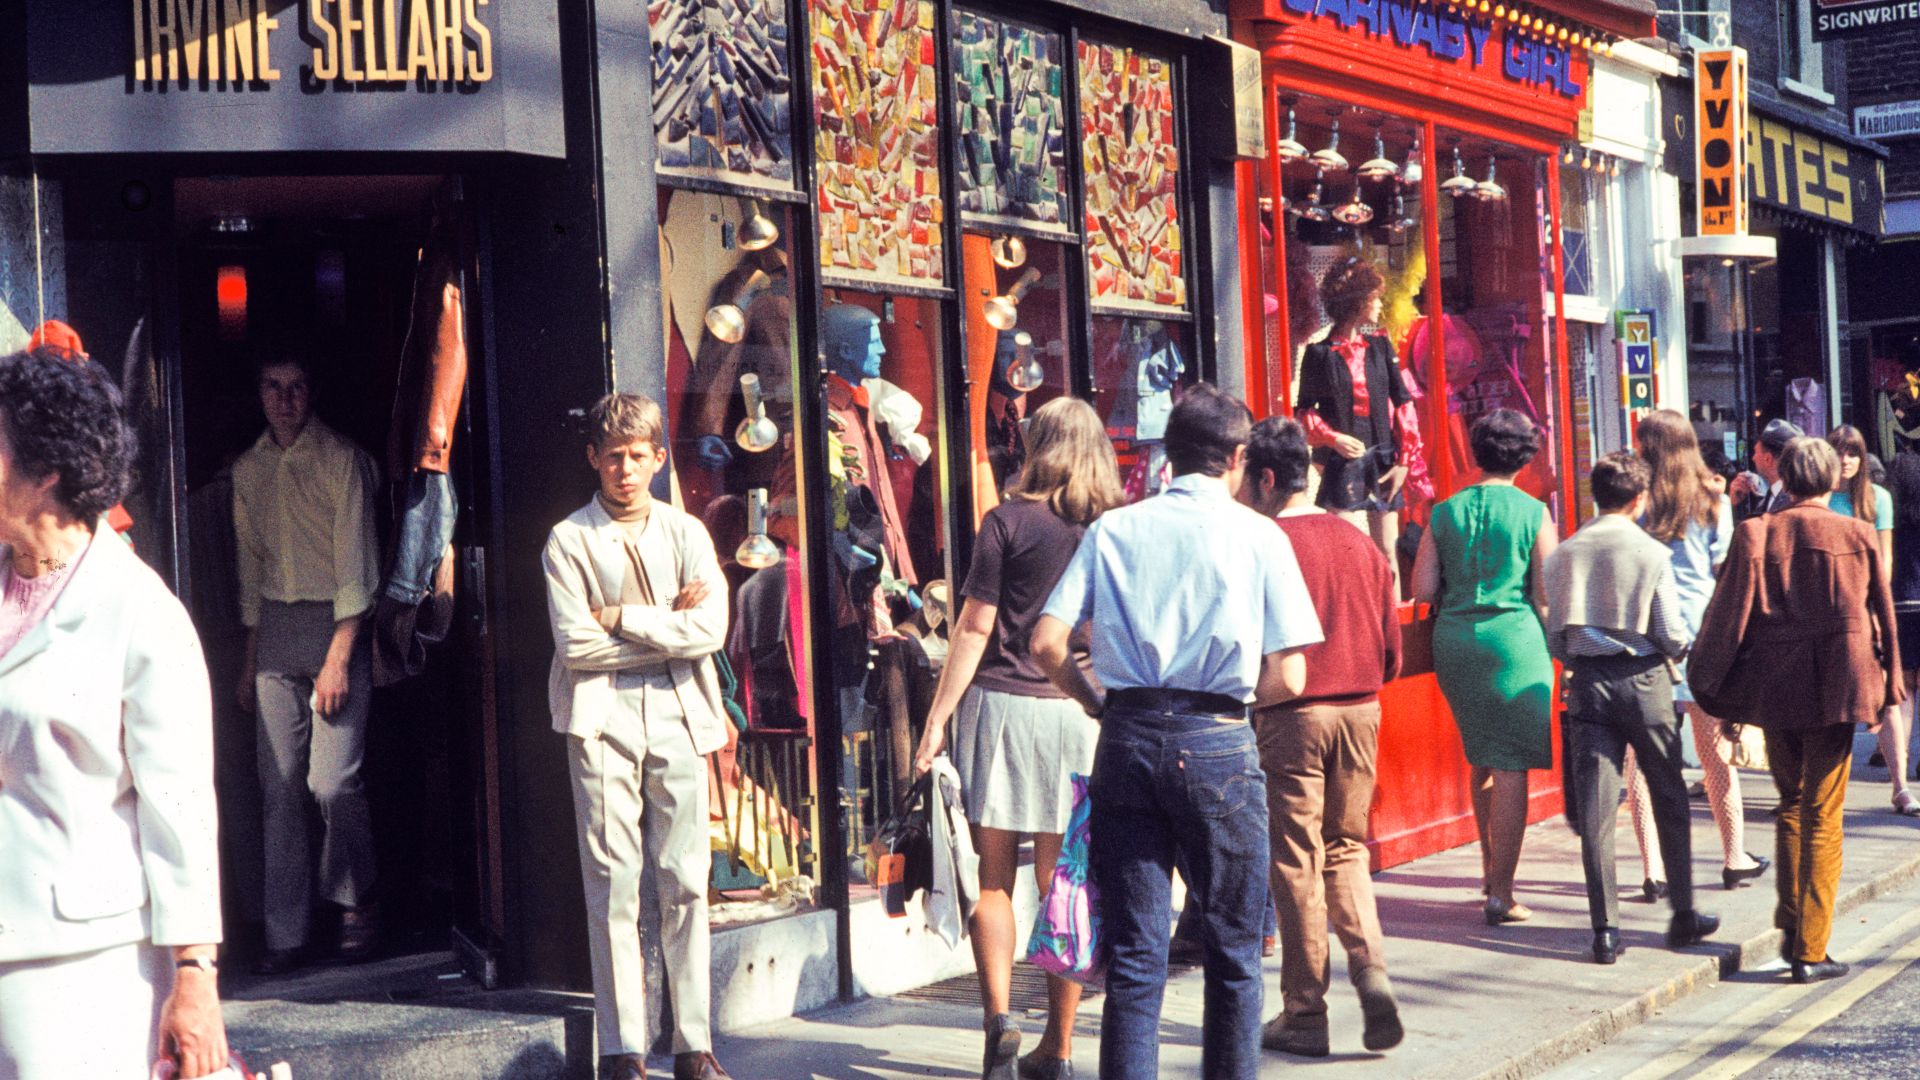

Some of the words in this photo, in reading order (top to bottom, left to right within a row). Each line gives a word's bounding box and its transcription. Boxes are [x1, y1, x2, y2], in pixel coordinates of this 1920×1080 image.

[135, 0, 280, 81] IRVINE
[311, 0, 493, 82] SELLARS
[1286, 0, 1490, 66] ARNABY
[1505, 28, 1581, 96] GIRL
[1818, 2, 1920, 31] SIGNWRITE
